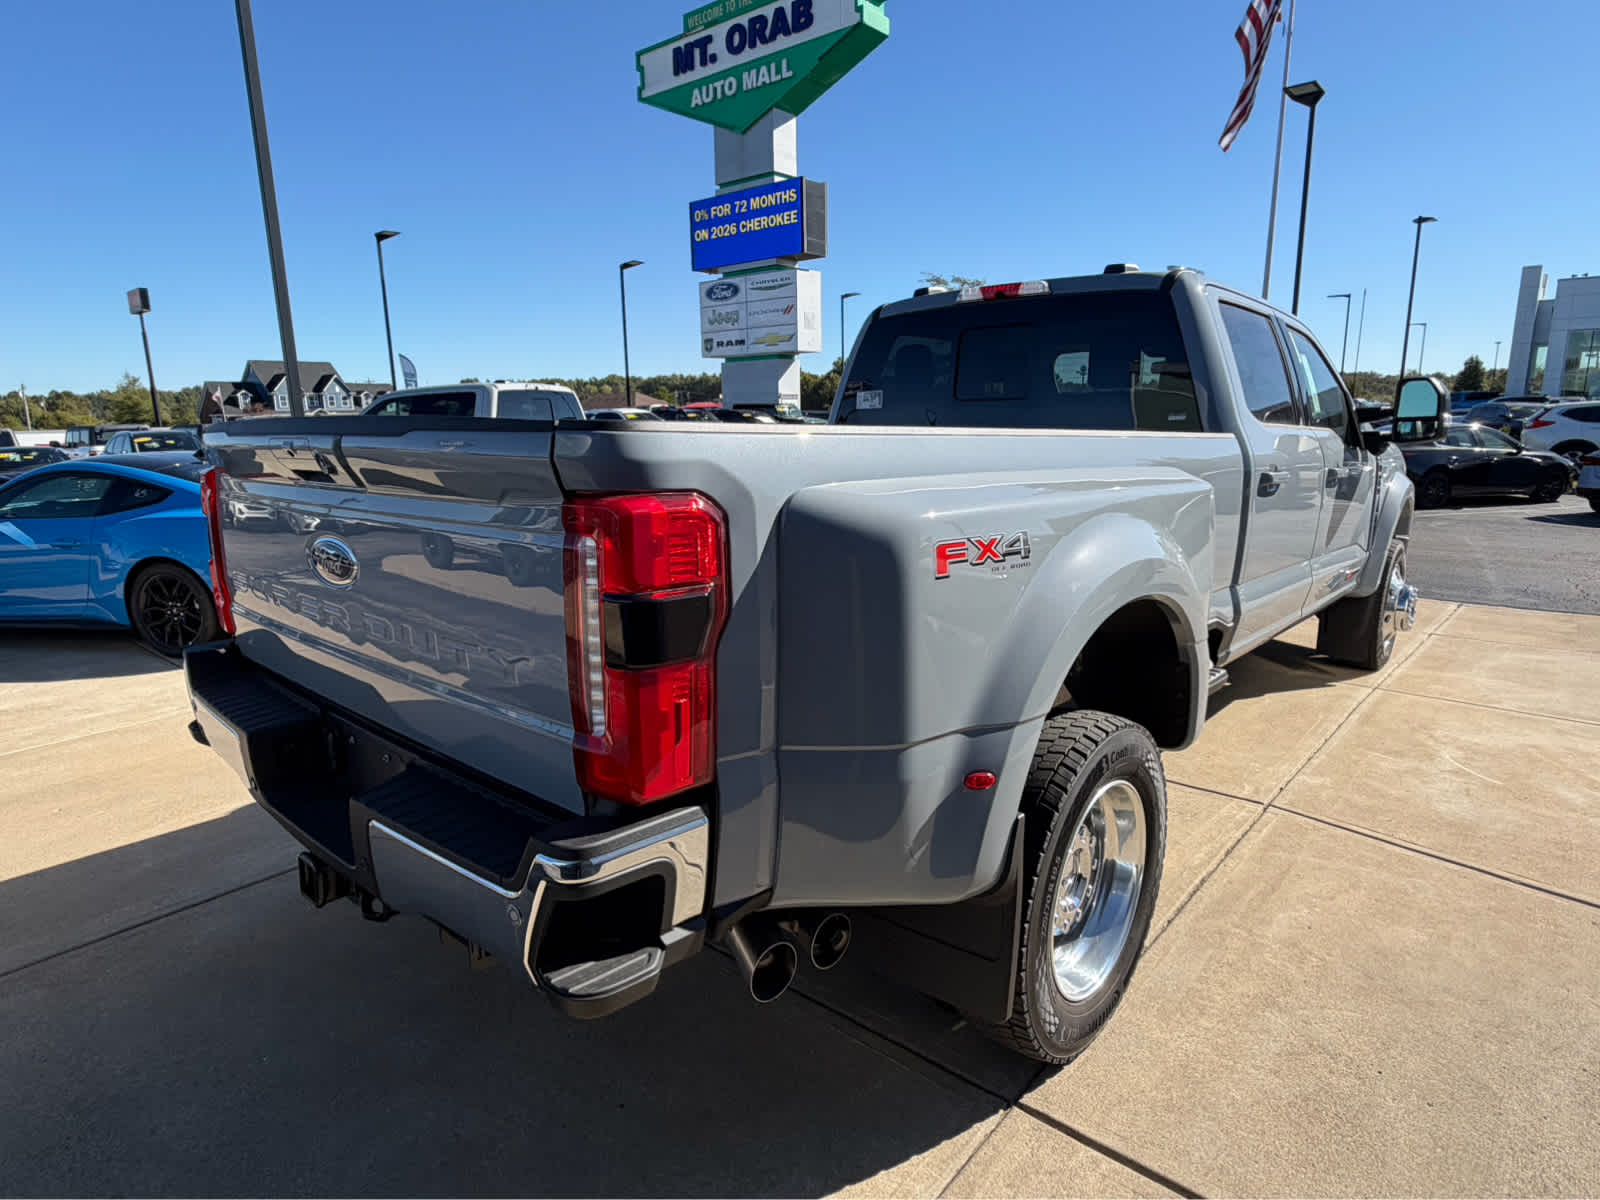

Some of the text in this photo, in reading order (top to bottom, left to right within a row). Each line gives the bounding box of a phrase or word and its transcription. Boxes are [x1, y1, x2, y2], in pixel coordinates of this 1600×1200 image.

[687, 4, 724, 29] WELCOME
[725, 0, 736, 13] TO
[672, 0, 815, 78] MT. ORAB
[690, 58, 793, 108] AUTO MALL
[694, 188, 798, 223] 0% FOR 72 MONTHS
[694, 209, 799, 242] ON 2026 CHEROKEE
[707, 309, 739, 326] Jeep
[716, 338, 746, 348] RAM
[934, 529, 1031, 580] FX4
[231, 569, 536, 688] SUPER DUTY
